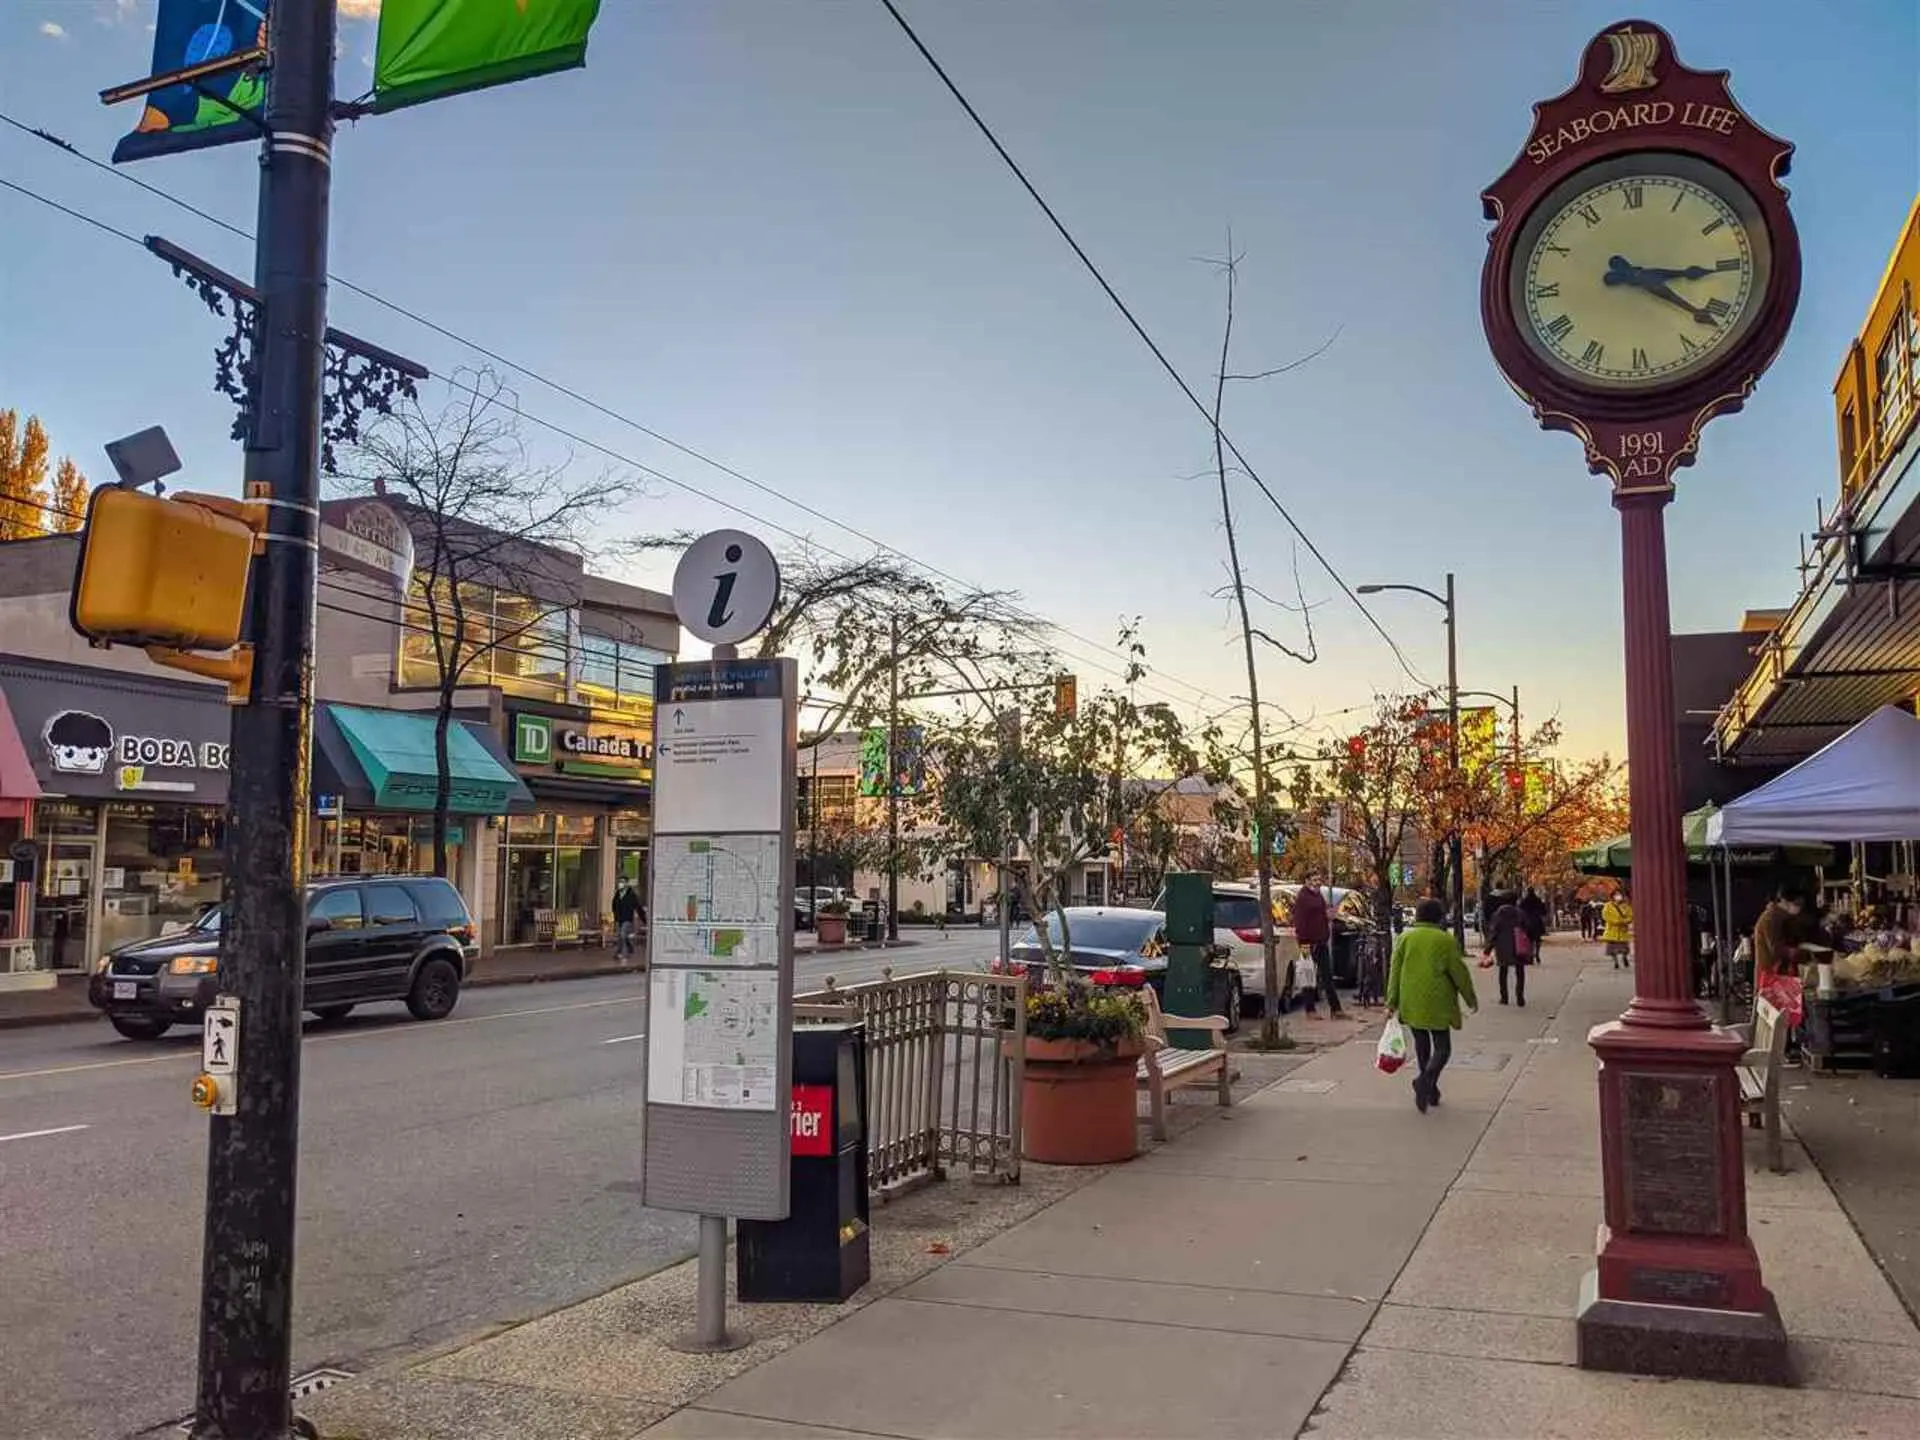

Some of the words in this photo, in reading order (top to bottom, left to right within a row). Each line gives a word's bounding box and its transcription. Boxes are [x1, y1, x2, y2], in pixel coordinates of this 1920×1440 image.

[1528, 102, 1674, 164] SEABOARD
[1681, 103, 1740, 135] LIFE
[1622, 187, 1643, 210] XII
[1578, 205, 1601, 228] XI
[1582, 340, 1604, 365] VII
[1632, 348, 1648, 370] VI
[1619, 431, 1664, 456] 1991
[1624, 456, 1662, 477] AD
[707, 544, 743, 628] i
[520, 723, 549, 754] TD
[563, 729, 631, 757] Canada
[120, 736, 196, 768] BOBA
